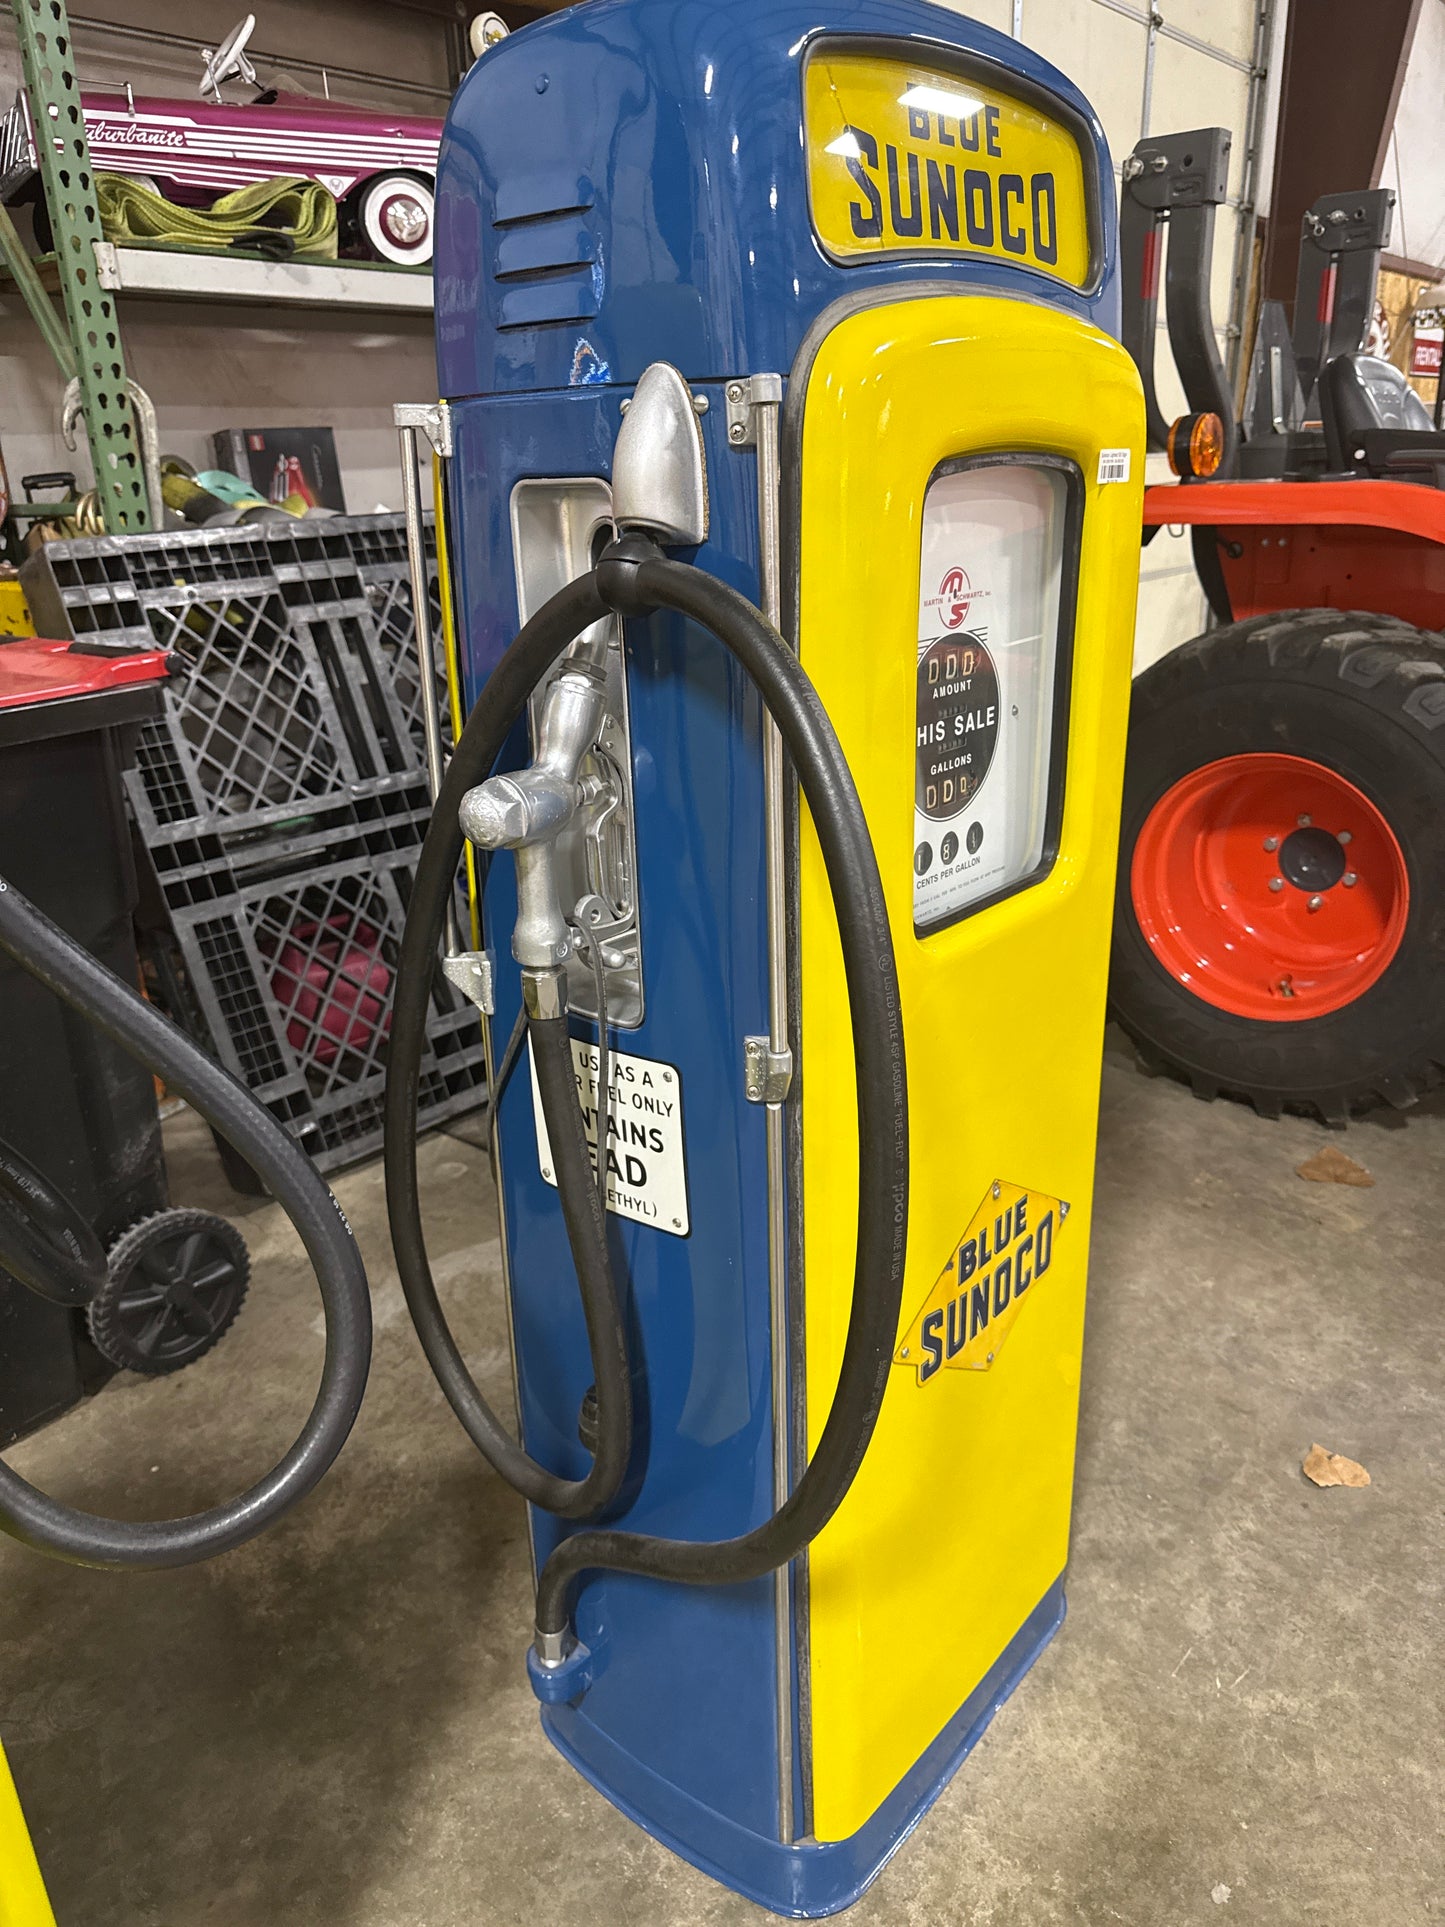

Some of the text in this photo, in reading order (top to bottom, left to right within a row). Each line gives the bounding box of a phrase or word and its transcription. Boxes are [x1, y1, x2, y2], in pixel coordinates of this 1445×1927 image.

[84, 119, 184, 147] uburbanite
[907, 82, 1001, 158] BLUE
[844, 124, 1057, 266] SUNOCO
[932, 679, 972, 699] AMOUNT
[917, 720, 946, 748] HIS
[954, 705, 995, 736] SALE
[930, 753, 972, 775] GALLONS
[916, 873, 939, 890] CENTS
[940, 867, 954, 880] PER
[955, 856, 981, 873] GALLON
[884, 976, 895, 1008] LISTED
[887, 1011, 899, 1038] STYLE
[614, 1063, 635, 1083] AS
[642, 1071, 654, 1088] A
[891, 1061, 903, 1107] GASOLINE
[589, 1080, 627, 1105] FEL
[632, 1093, 673, 1118] ONLY
[958, 1194, 1028, 1287] BLUE
[921, 1210, 1053, 1382] SUNOCO
